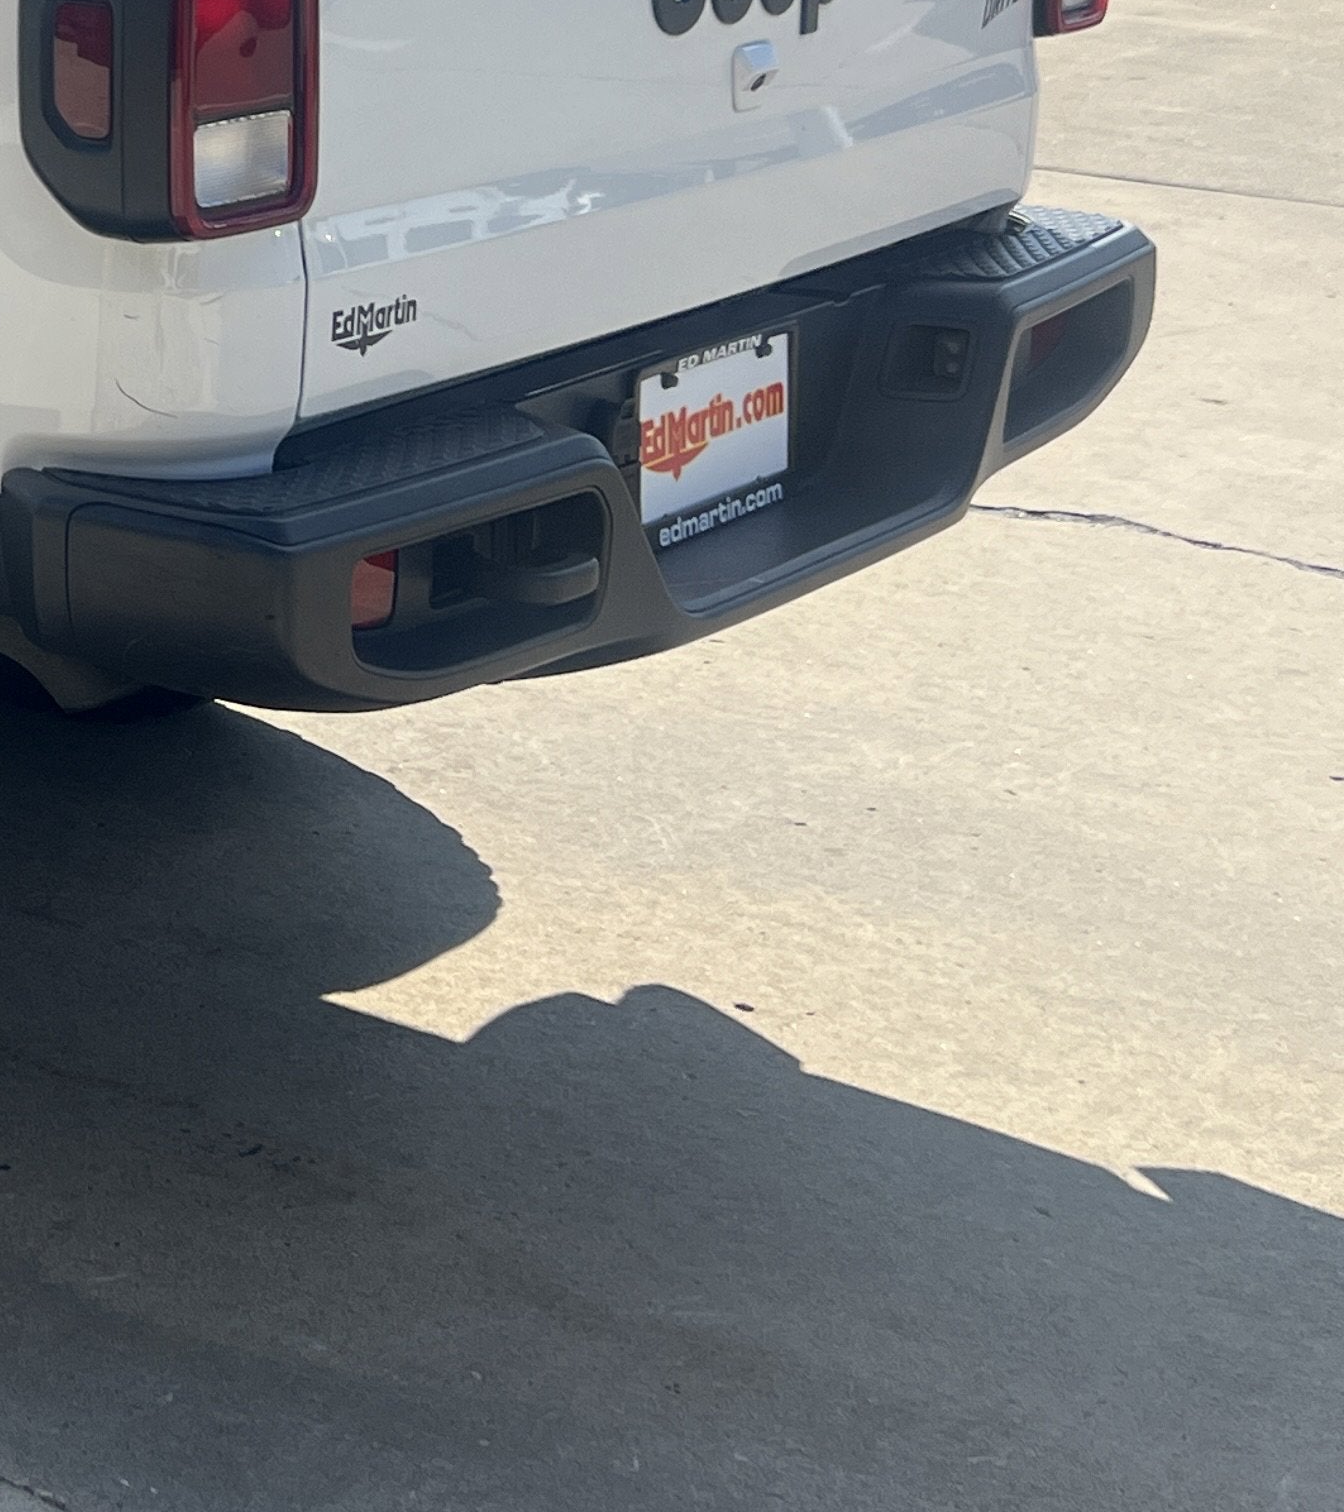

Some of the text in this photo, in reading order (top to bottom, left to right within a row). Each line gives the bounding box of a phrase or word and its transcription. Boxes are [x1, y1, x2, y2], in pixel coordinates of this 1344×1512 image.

[677, 334, 763, 374] ED MARTIN
[640, 382, 785, 465] EdMartin.com
[659, 483, 784, 547] edmartin.com
